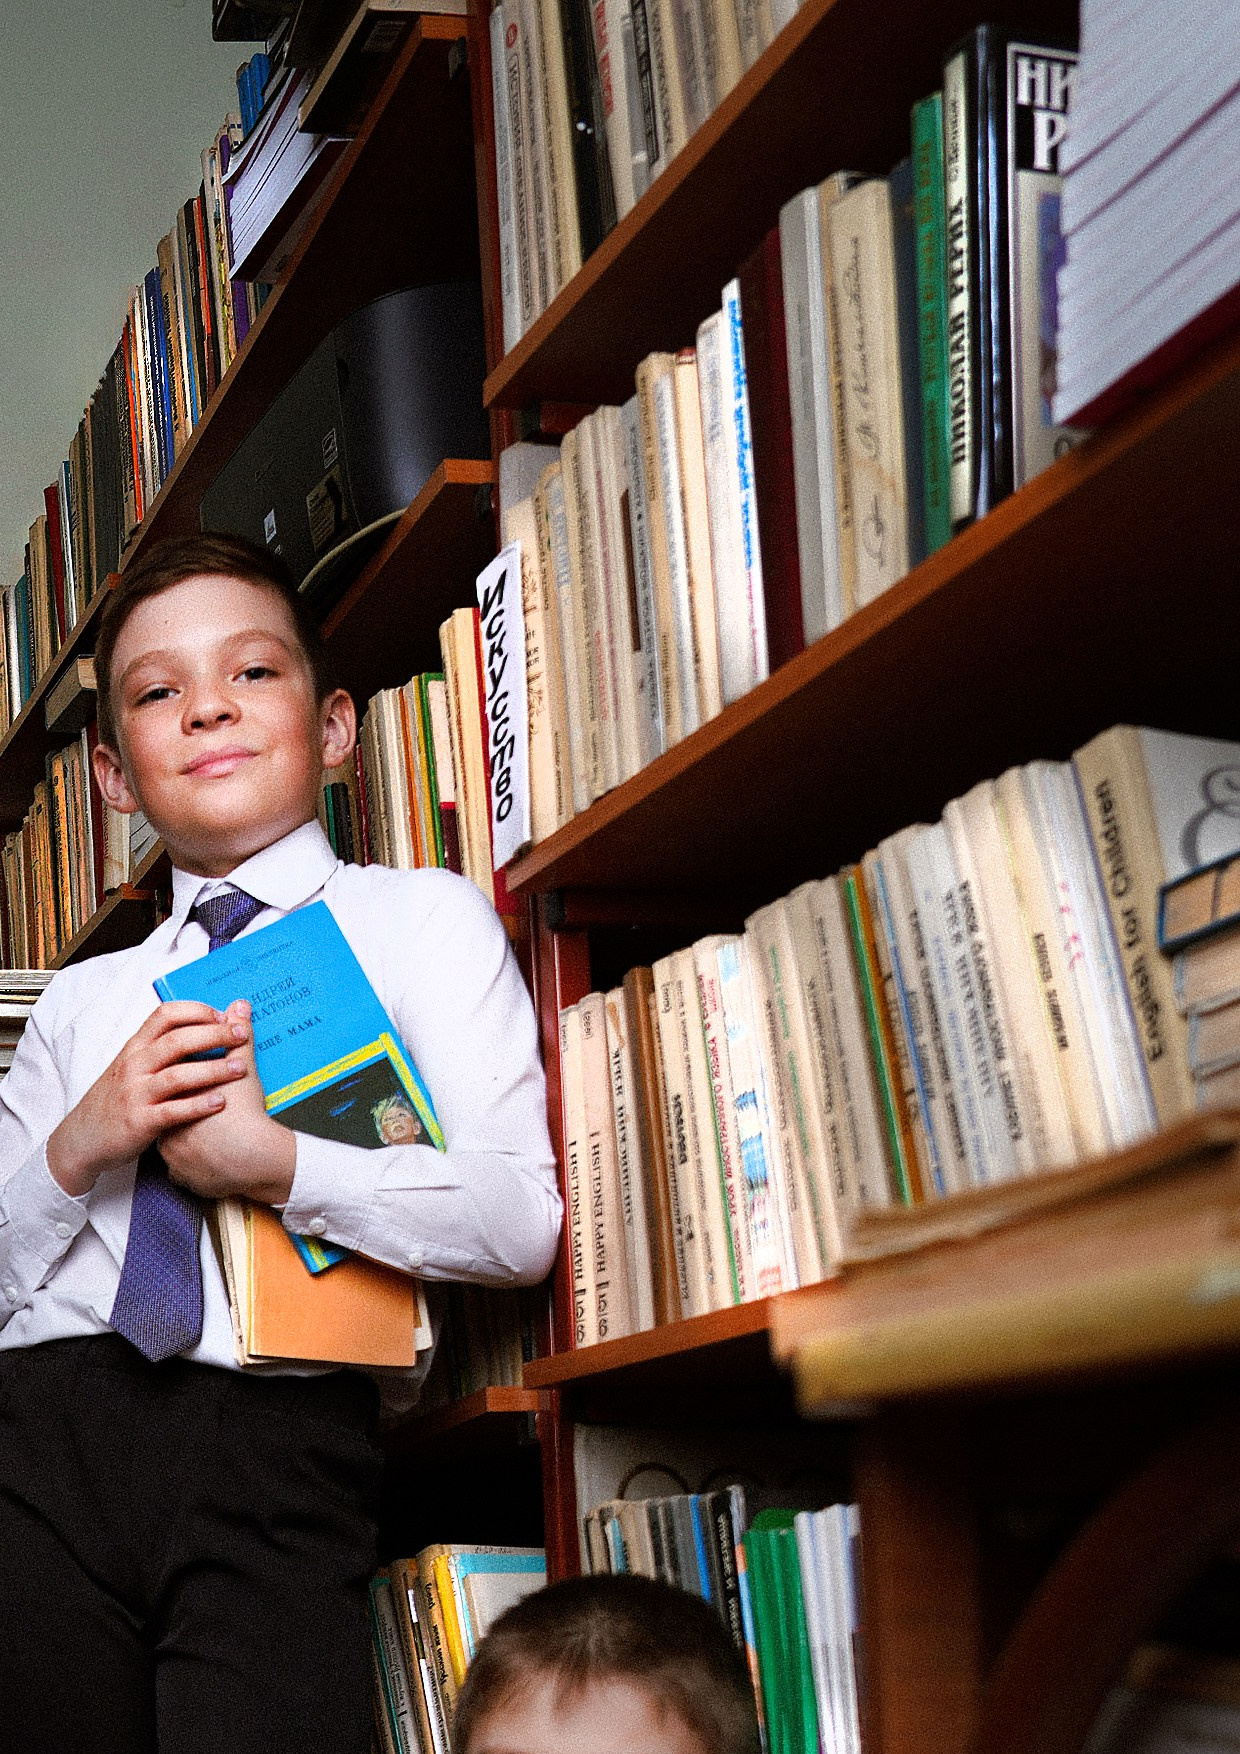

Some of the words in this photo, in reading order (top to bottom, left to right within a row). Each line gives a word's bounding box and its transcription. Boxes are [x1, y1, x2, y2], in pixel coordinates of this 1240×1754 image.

[949, 197, 965, 299] РЕРИХ
[1088, 778, 1132, 899] Children
[1117, 906, 1140, 949] for
[251, 976, 296, 1005] НДРЕЙ
[251, 987, 312, 1023] ЛАТОНОВ
[1128, 954, 1169, 1063] English
[287, 1015, 322, 1037] МАМА
[571, 1152, 583, 1226] ENGLISH
[592, 1143, 605, 1218] ENGLISH
[574, 1229, 585, 1281] HAPPY
[595, 1219, 608, 1274] HAPPY
